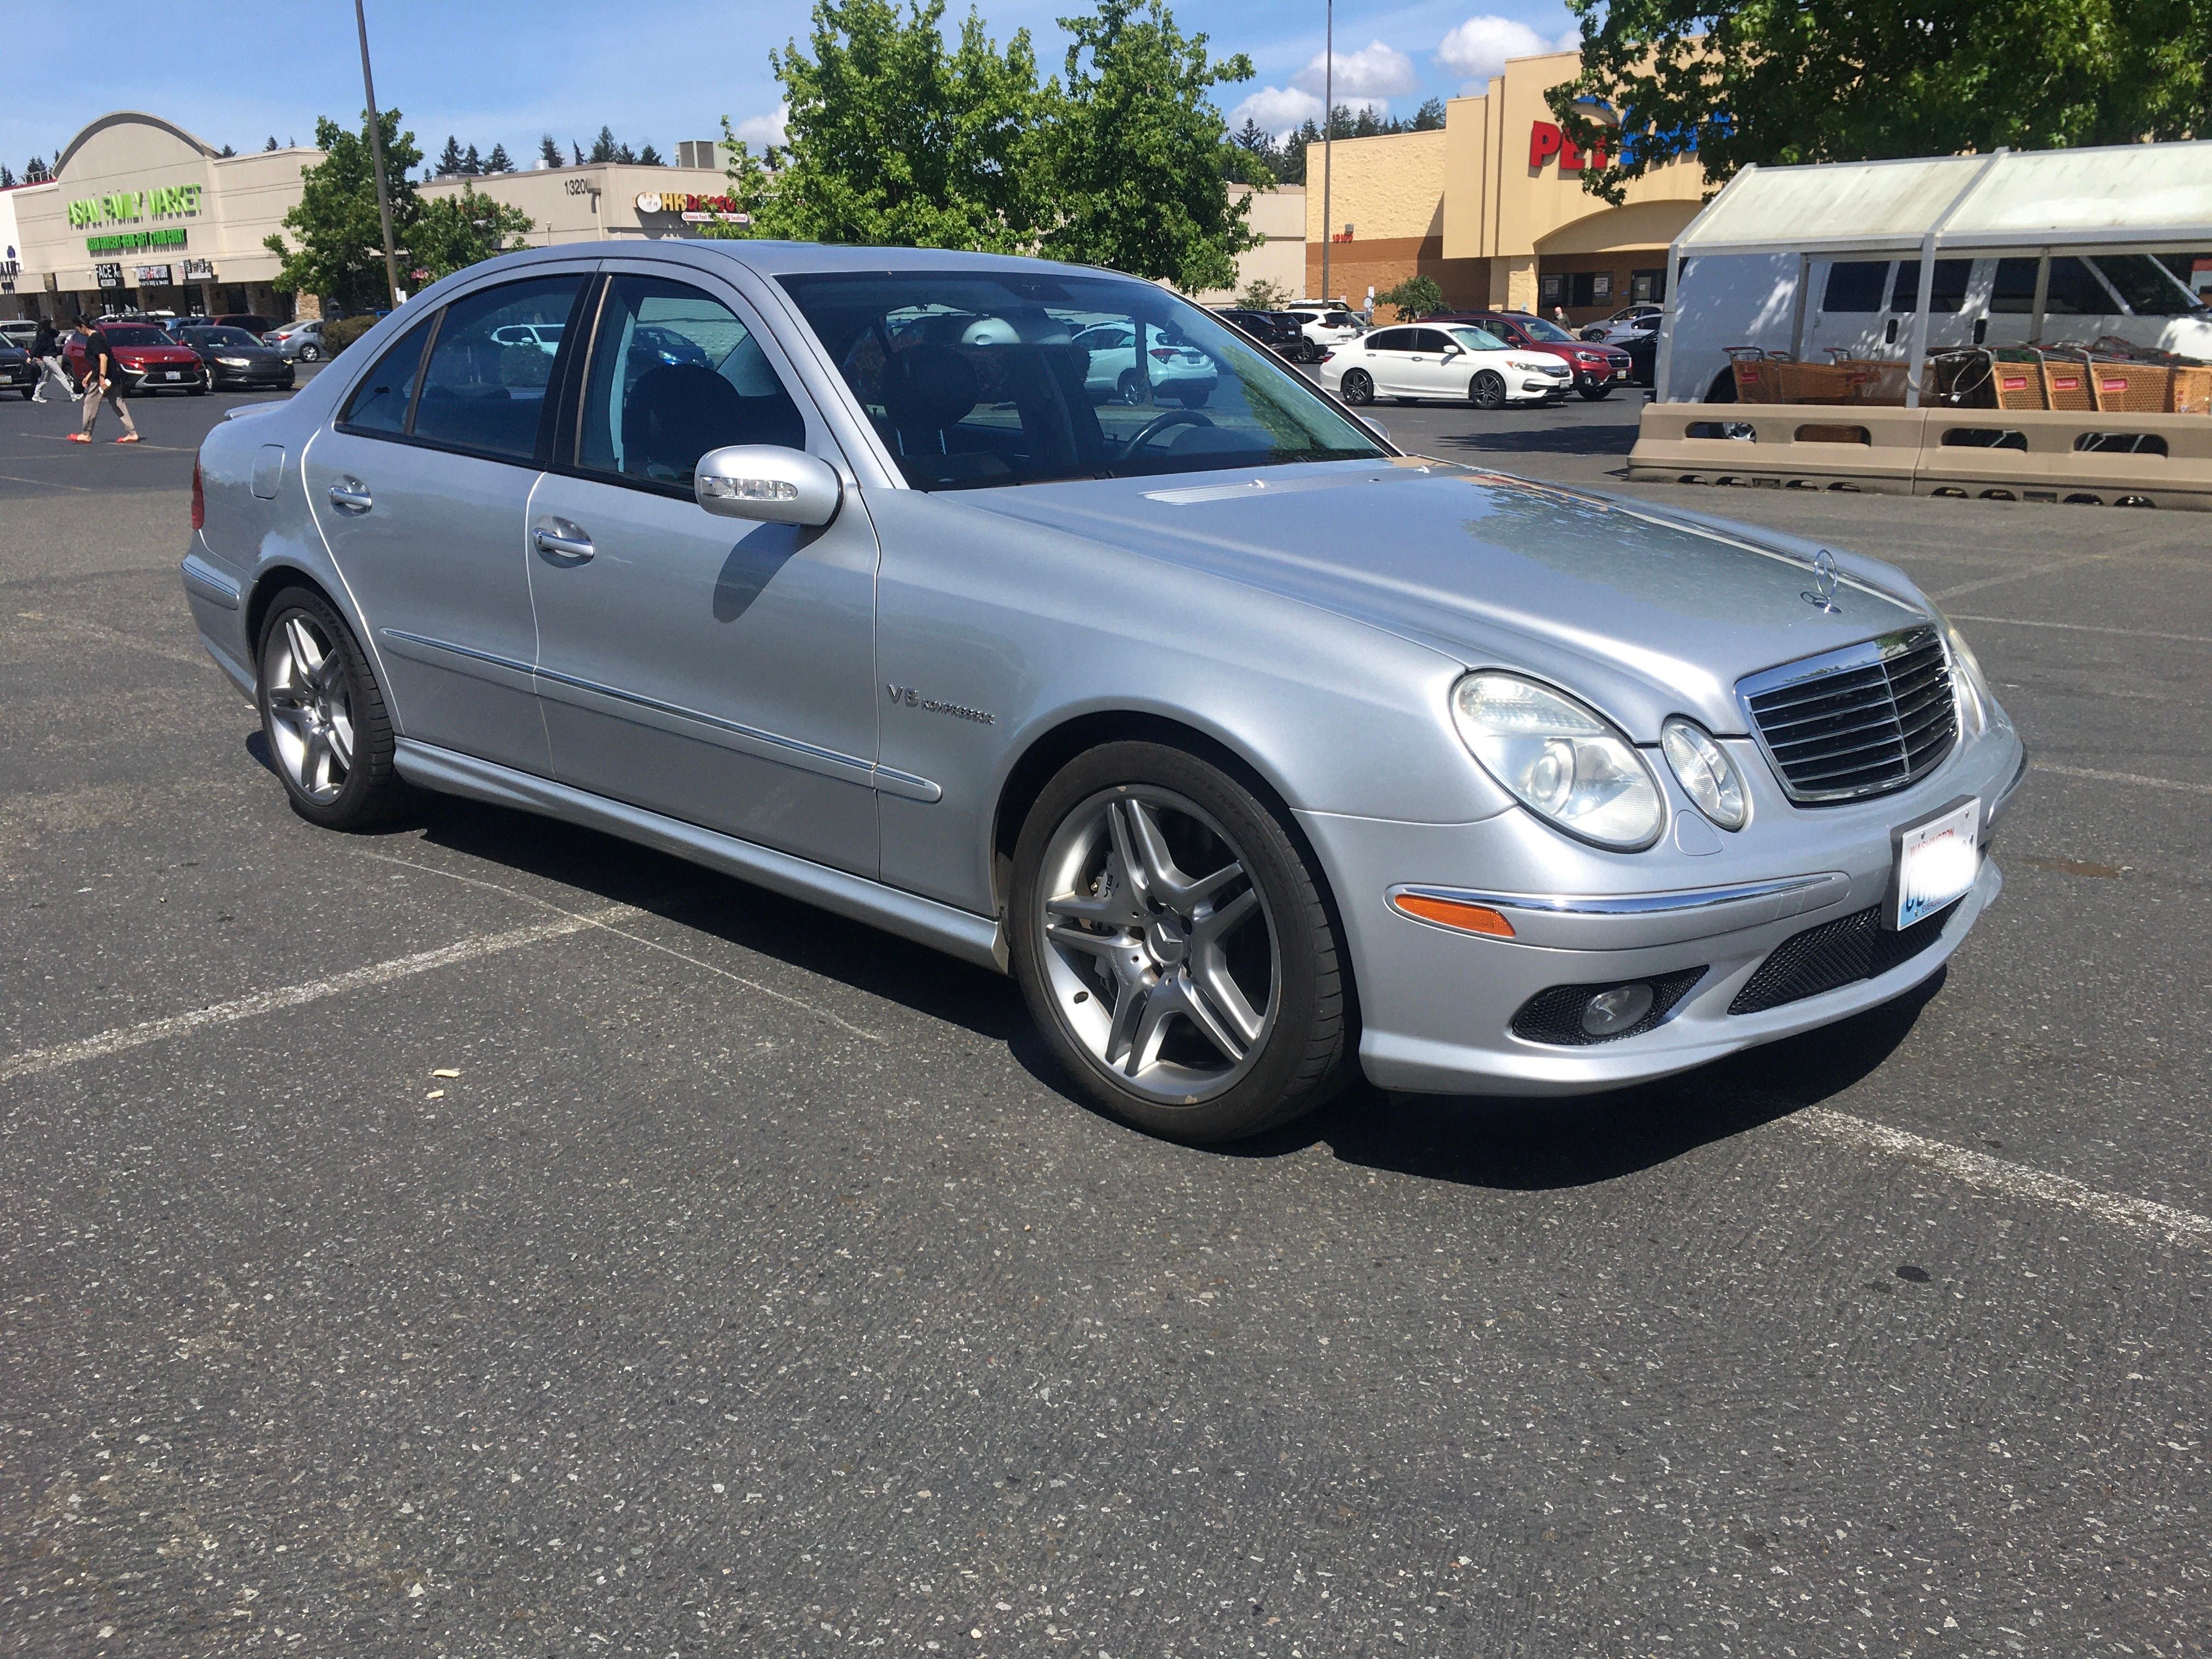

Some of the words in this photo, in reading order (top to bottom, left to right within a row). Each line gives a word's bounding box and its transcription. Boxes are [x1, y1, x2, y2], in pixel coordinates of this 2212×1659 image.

[68, 198, 100, 225] ASIAN
[147, 183, 202, 215] MARKET
[660, 193, 686, 211] HK
[95, 264, 112, 279] FACE
[112, 264, 119, 278] X
[887, 684, 918, 707] V8
[921, 698, 995, 726] KOMPRESSOR
